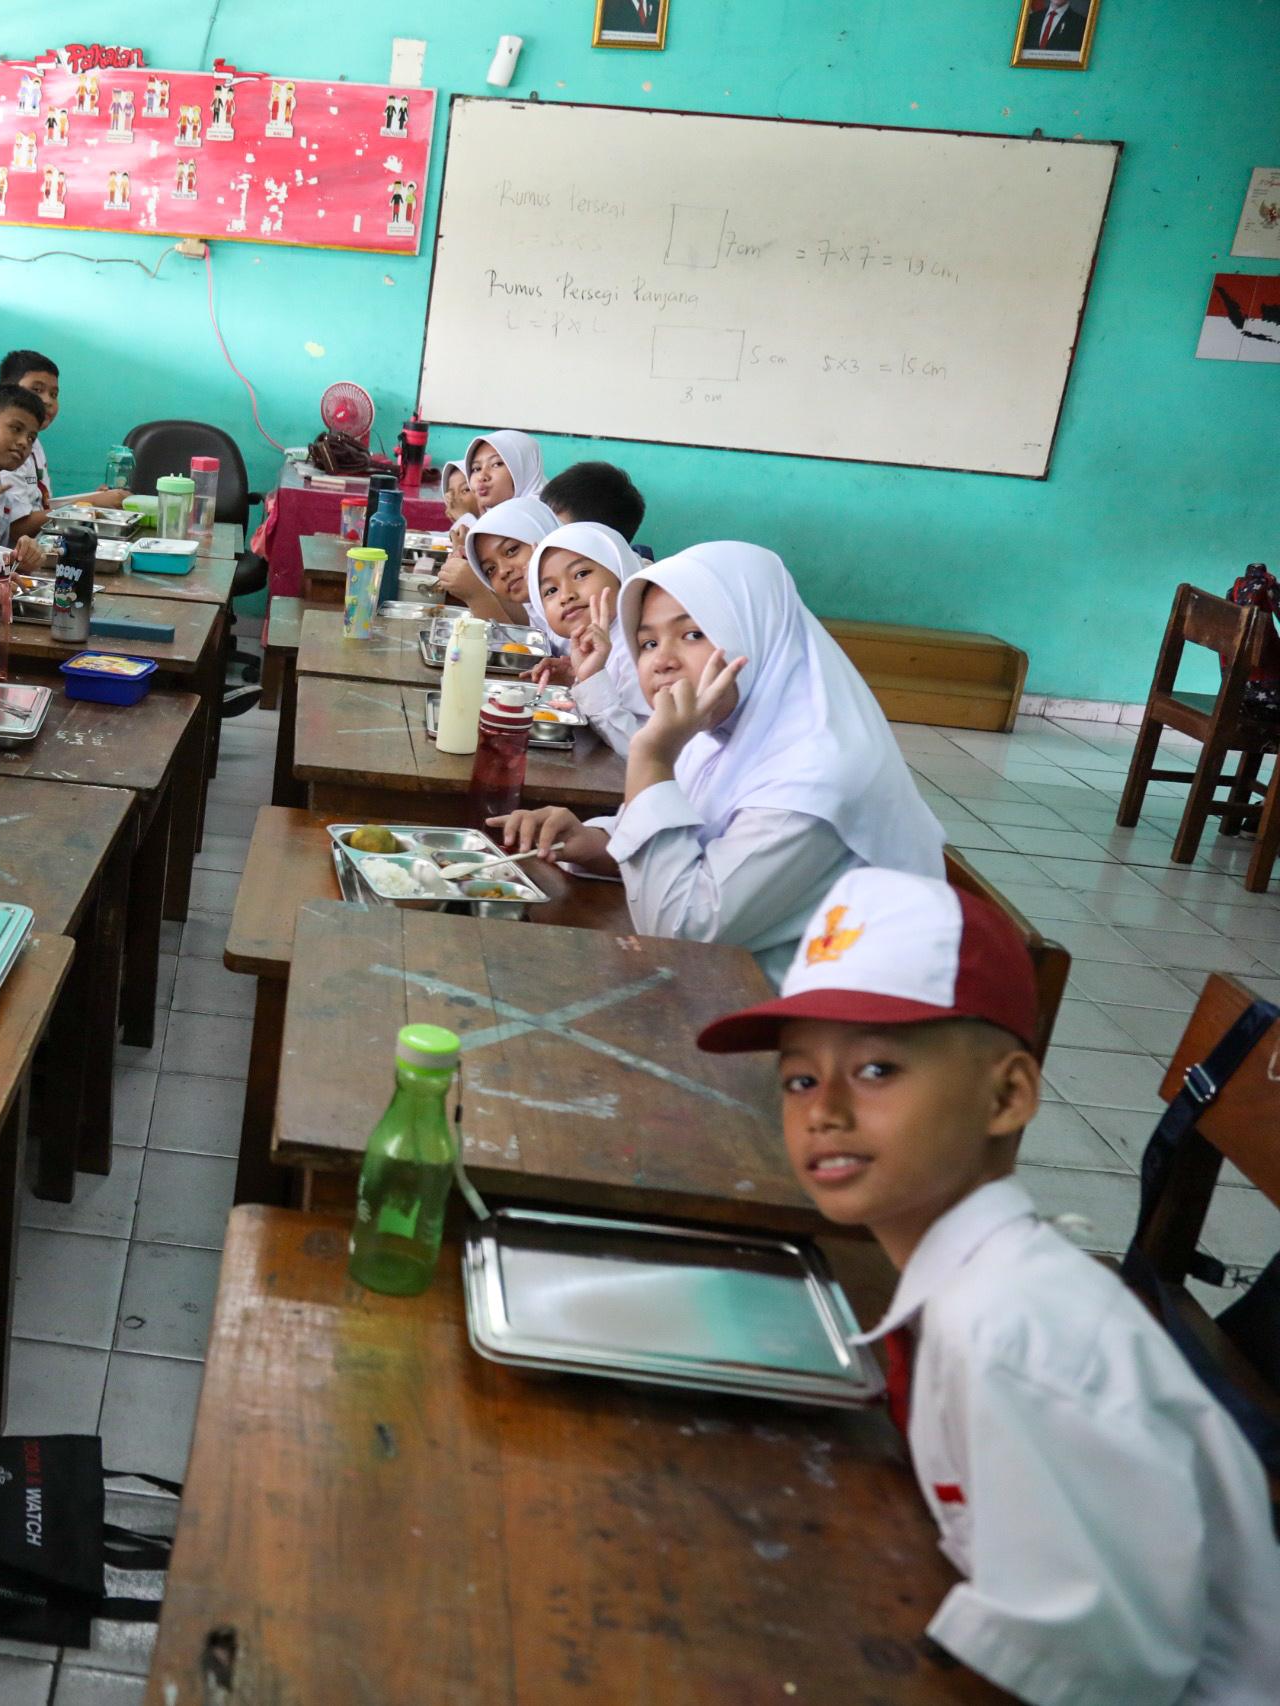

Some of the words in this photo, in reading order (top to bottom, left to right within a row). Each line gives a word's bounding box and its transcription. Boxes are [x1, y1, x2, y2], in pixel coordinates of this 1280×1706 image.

[64, 43, 145, 73] Pakaian
[495, 179, 551, 206] Rumus
[485, 269, 543, 297] Rumus
[556, 271, 619, 306] Persegi
[632, 275, 699, 311] Panjang
[26, 1487, 42, 1547] WATCH
